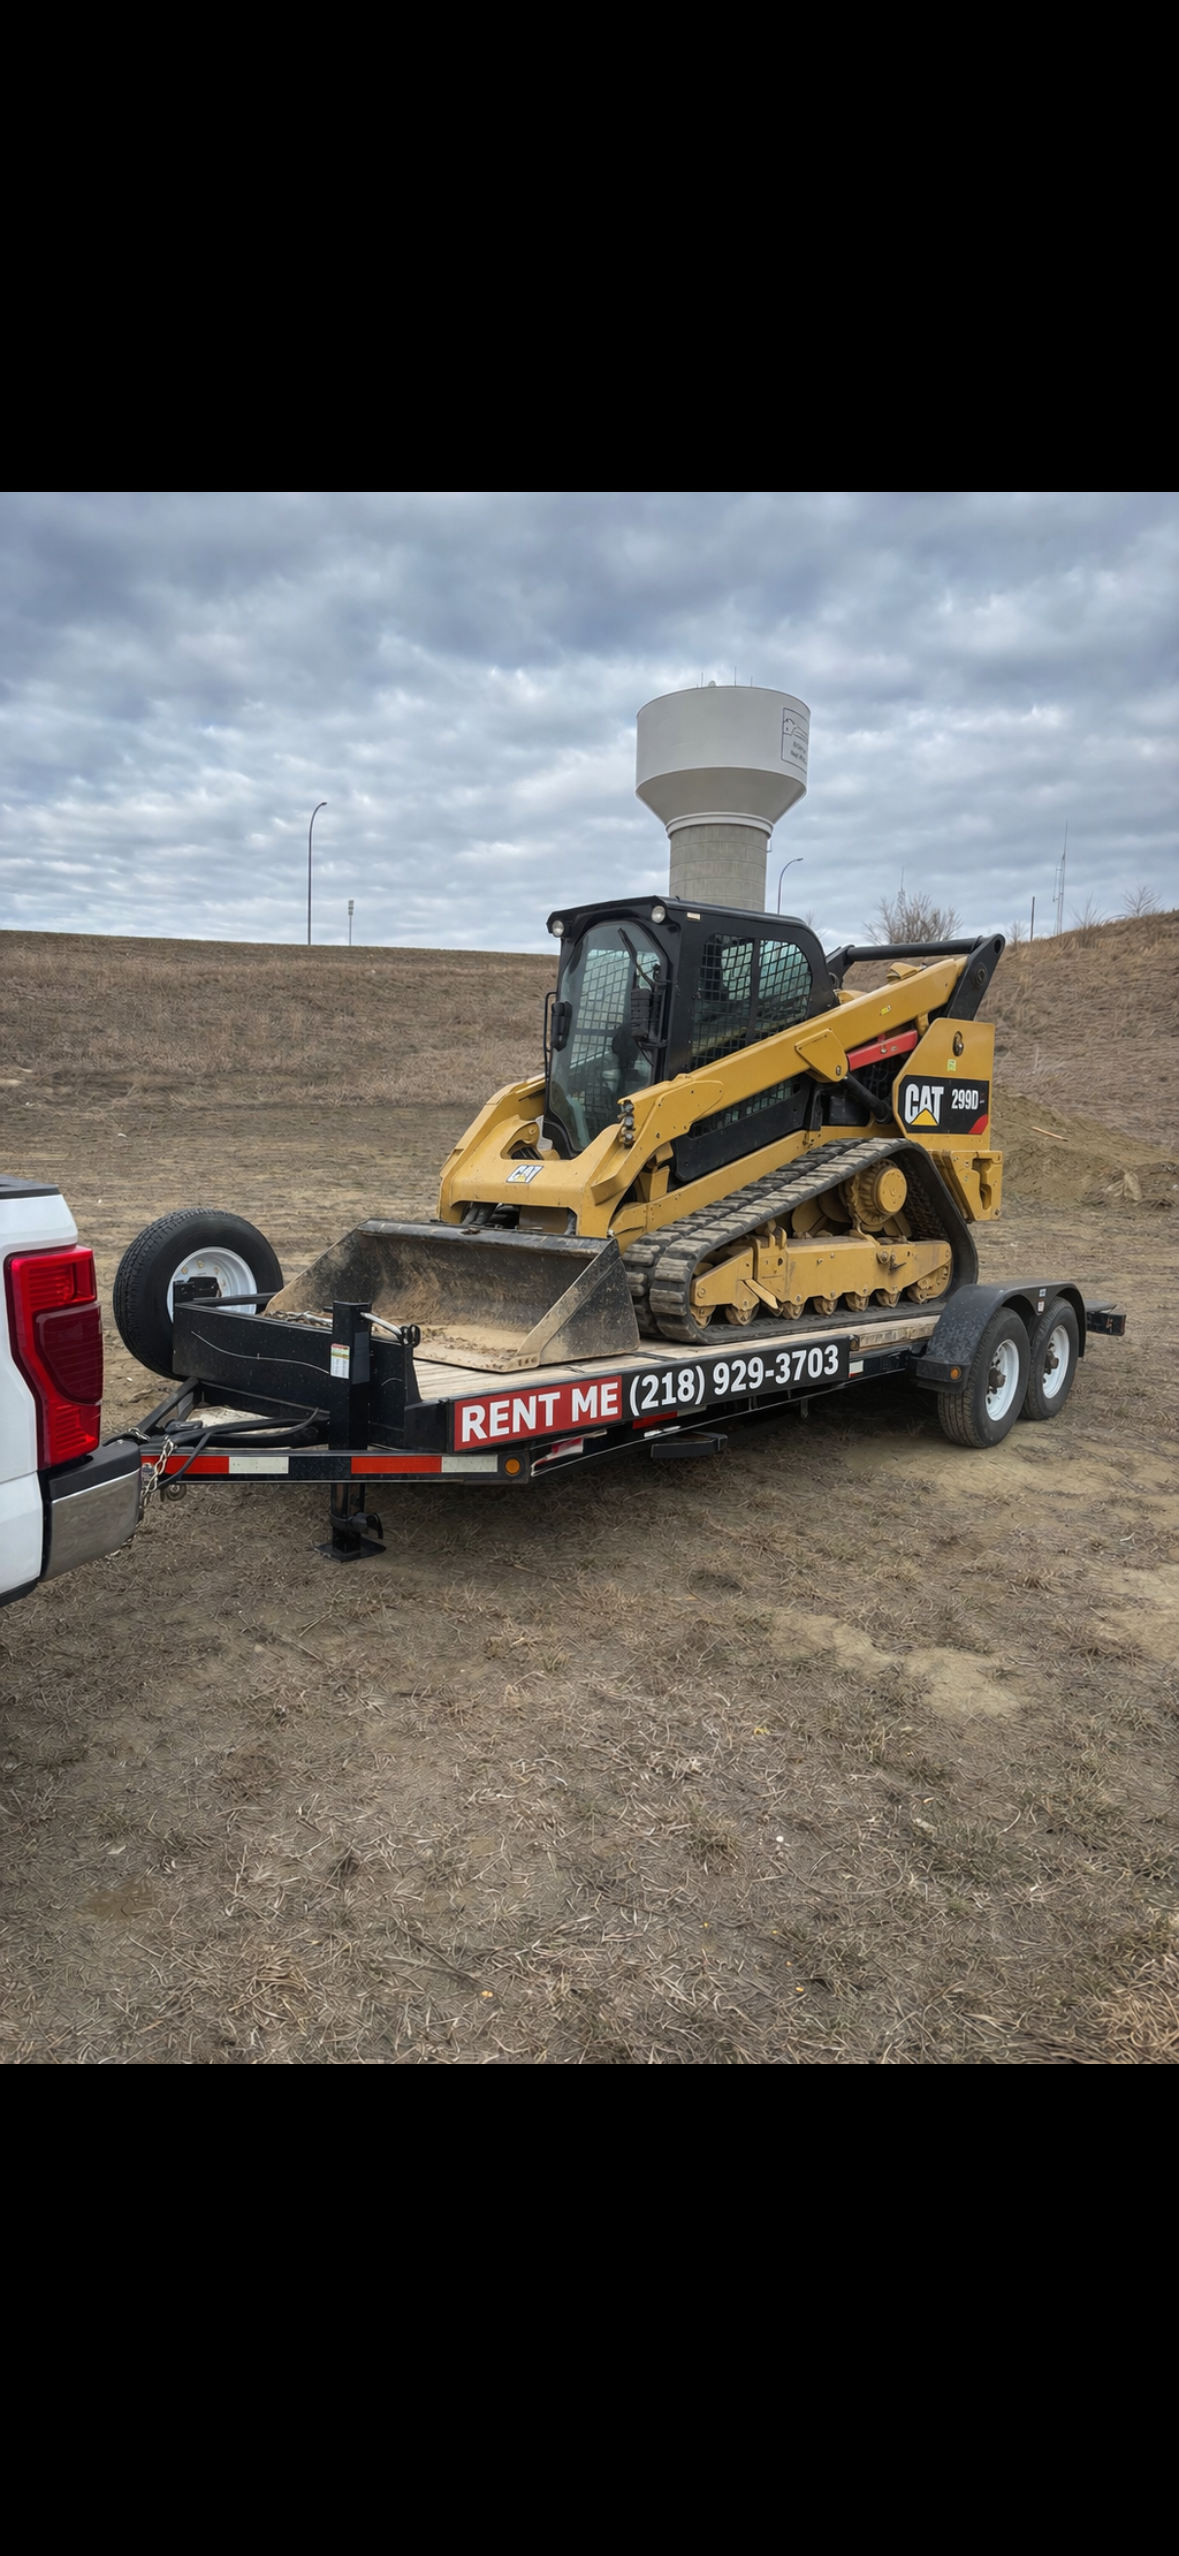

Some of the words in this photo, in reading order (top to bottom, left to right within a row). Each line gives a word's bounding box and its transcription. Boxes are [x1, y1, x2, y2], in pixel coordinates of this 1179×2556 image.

[905, 1083, 944, 1125] CAT
[951, 1089, 979, 1110] 299D
[507, 1165, 543, 1183] CAT
[462, 1391, 561, 1443] RENT
[571, 1382, 618, 1422] ME
[629, 1365, 706, 1417] (218)
[713, 1344, 839, 1396] 929-3703
